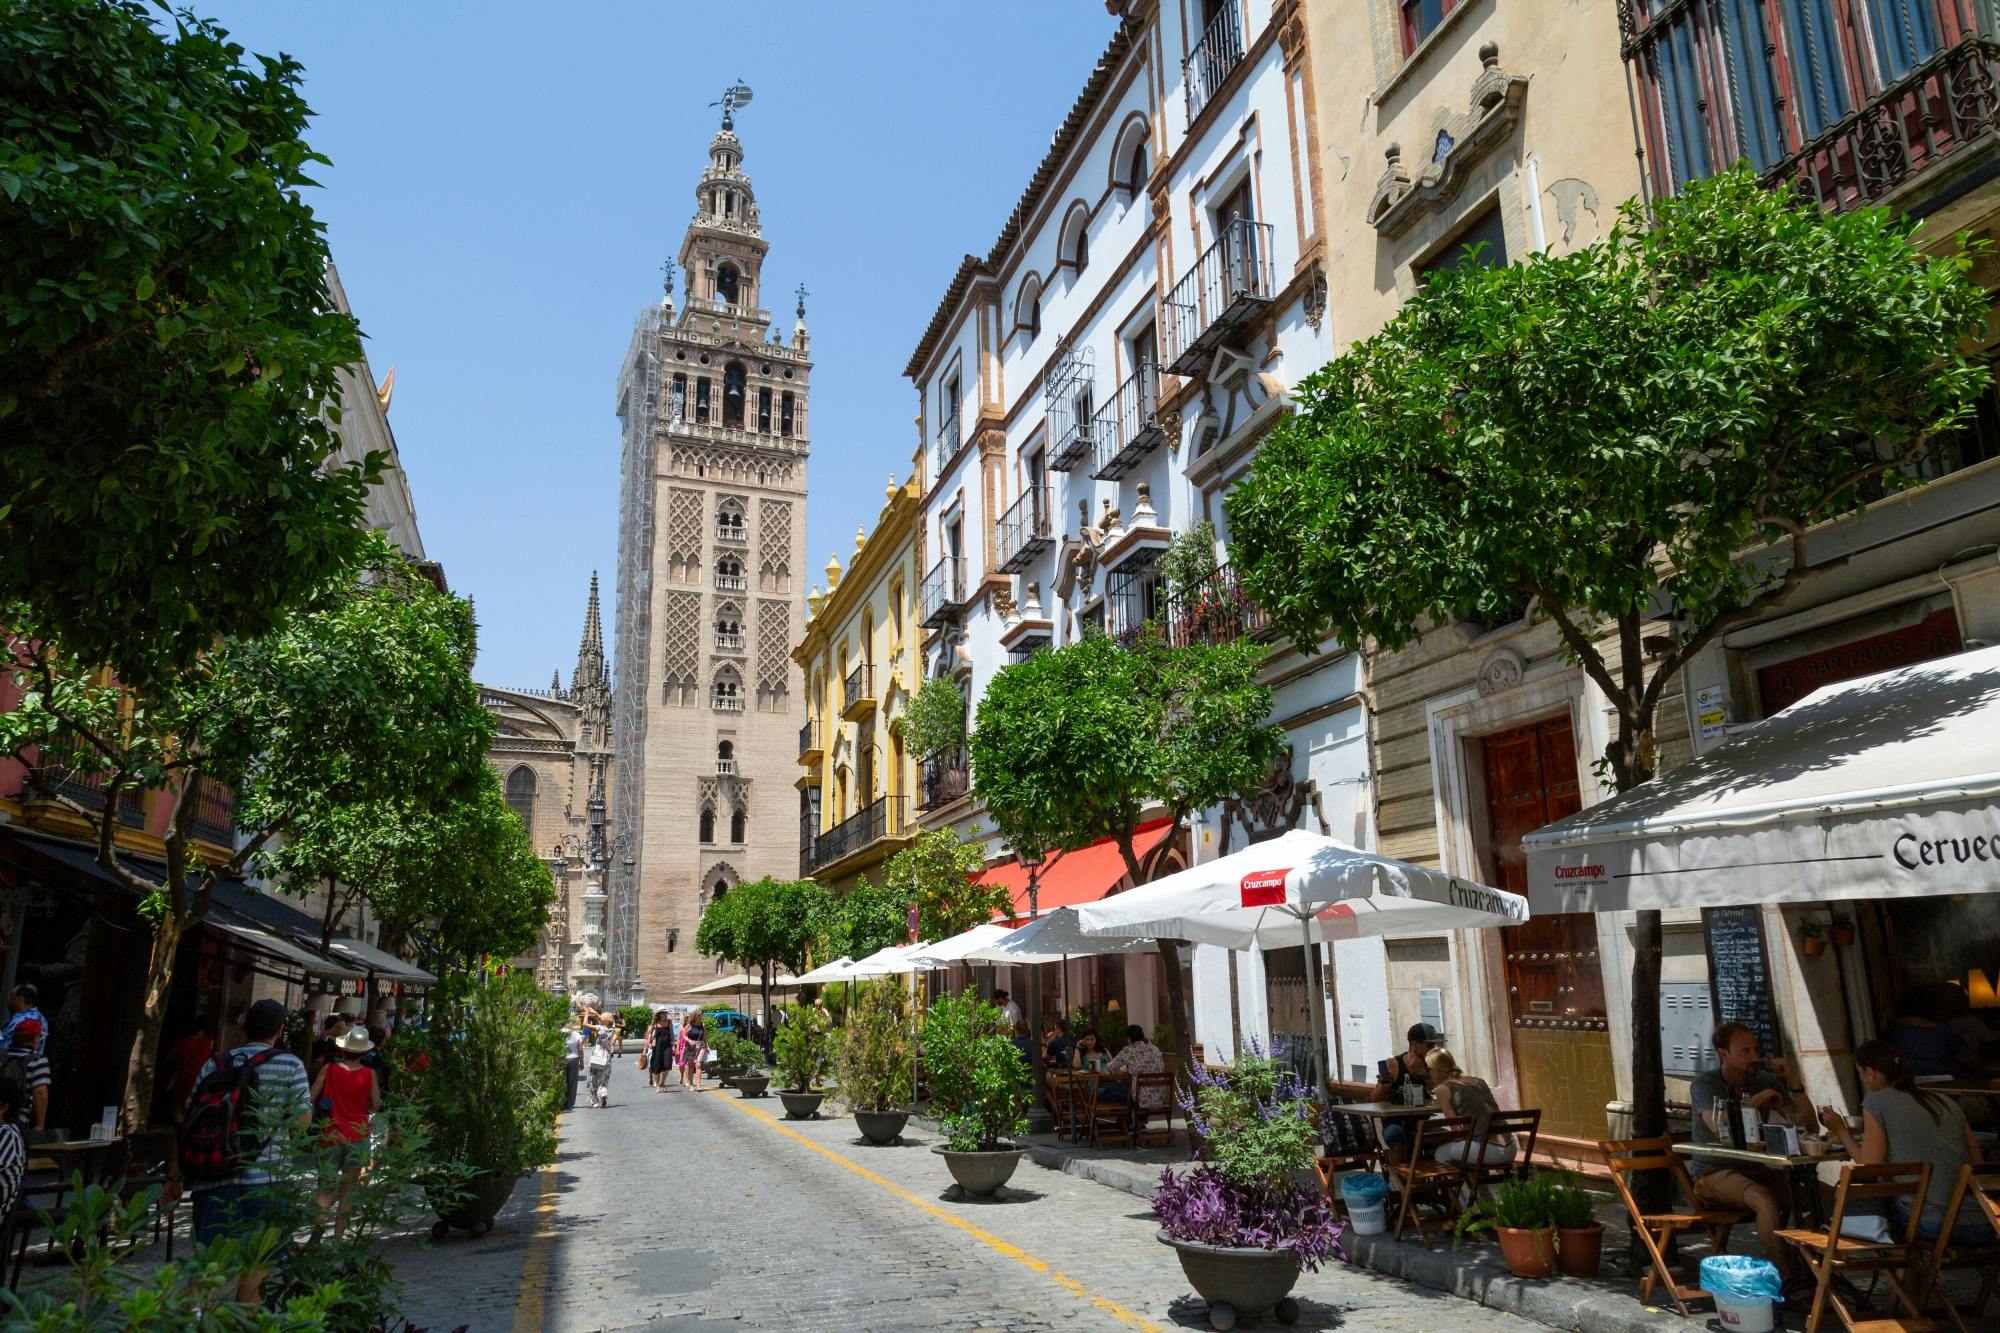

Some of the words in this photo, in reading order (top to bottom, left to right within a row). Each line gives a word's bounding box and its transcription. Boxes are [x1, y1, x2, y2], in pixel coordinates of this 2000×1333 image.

[1555, 864, 1606, 879] Cruzcampo
[1244, 879, 1282, 890] Cruzcampo
[326, 981, 335, 992] Bar
